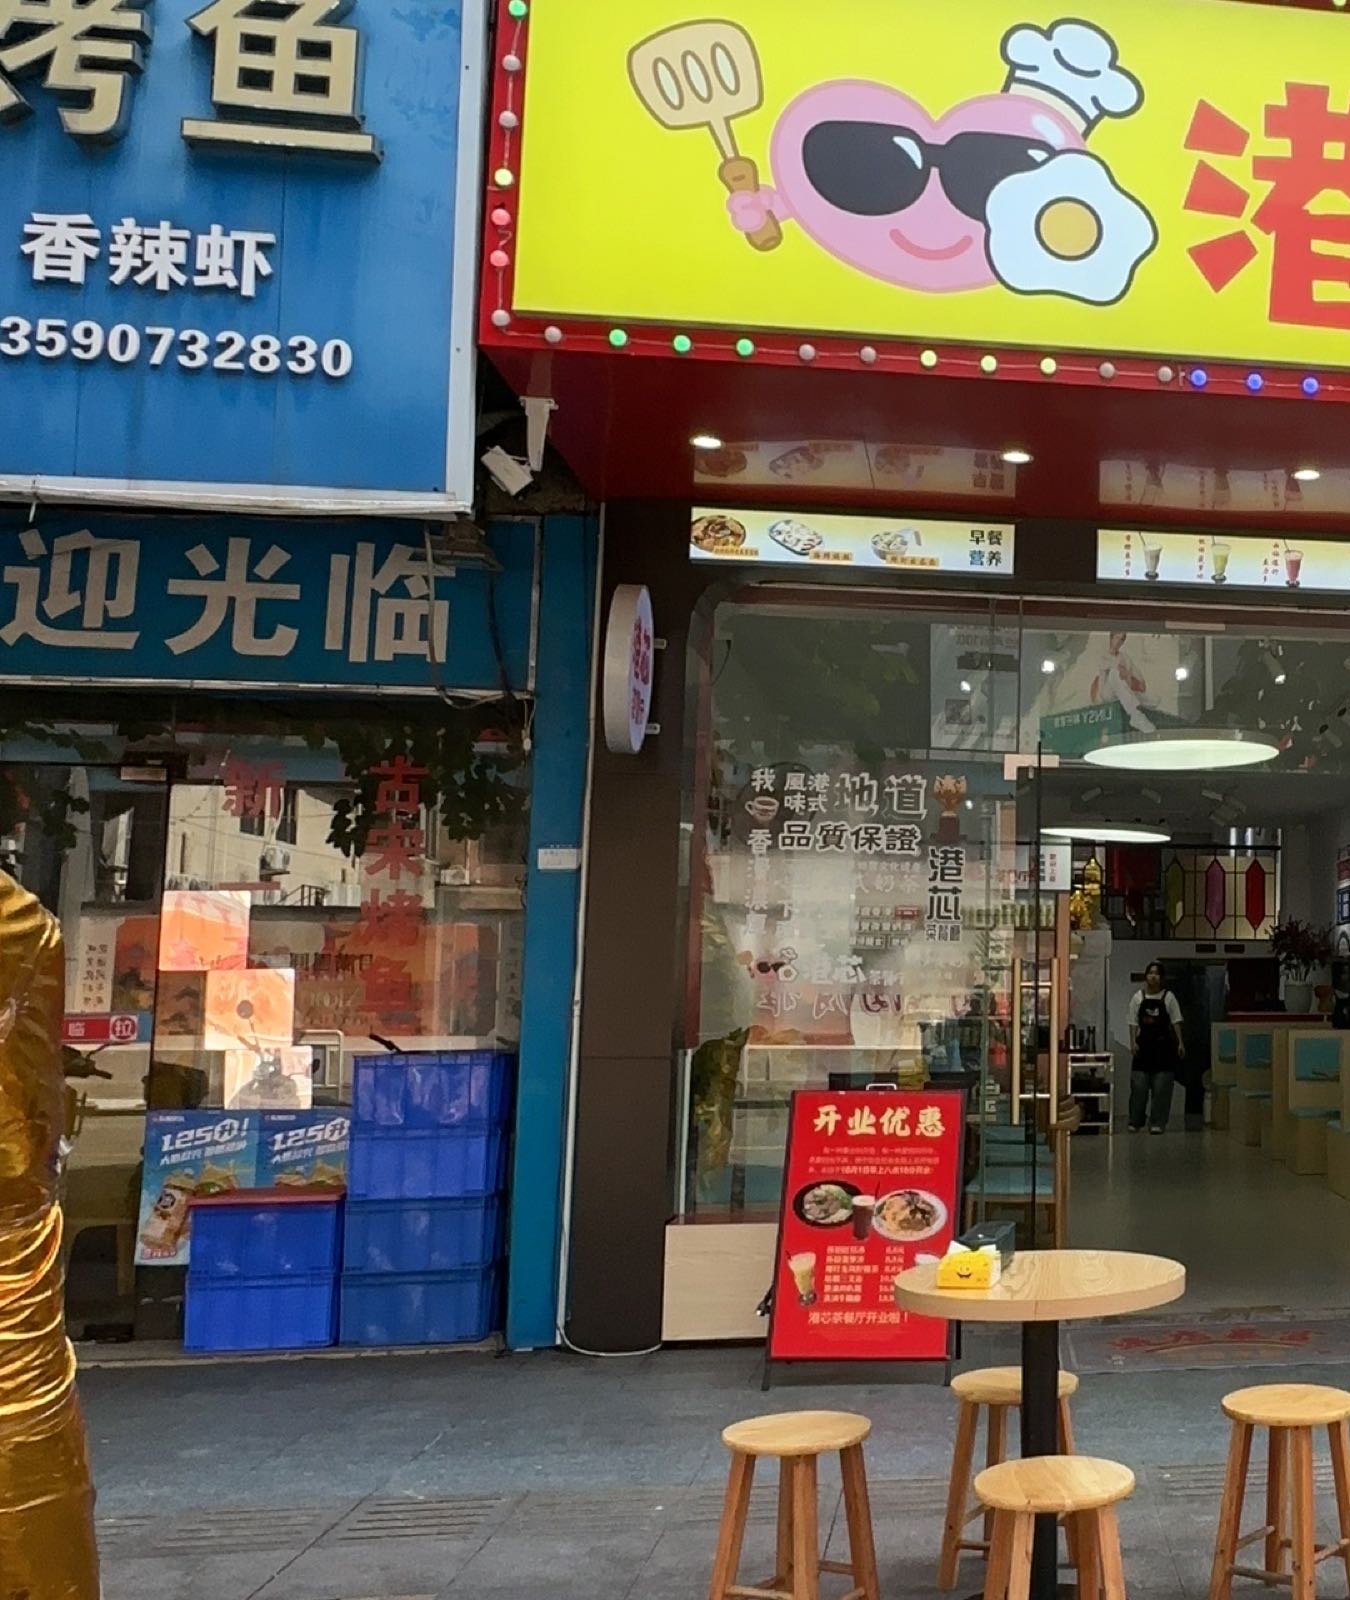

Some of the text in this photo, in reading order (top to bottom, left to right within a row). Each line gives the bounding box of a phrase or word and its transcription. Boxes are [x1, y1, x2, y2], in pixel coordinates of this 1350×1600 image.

[20, 212, 276, 297] 香辣虾
[0, 315, 353, 378] 3590732830
[969, 529, 1003, 545] 早餐
[969, 550, 1003, 567] 营养
[0, 529, 456, 663] 迎光临
[779, 821, 922, 856] 品質保證
[926, 846, 966, 922] 港芯
[813, 1104, 945, 1138] 开业优惠
